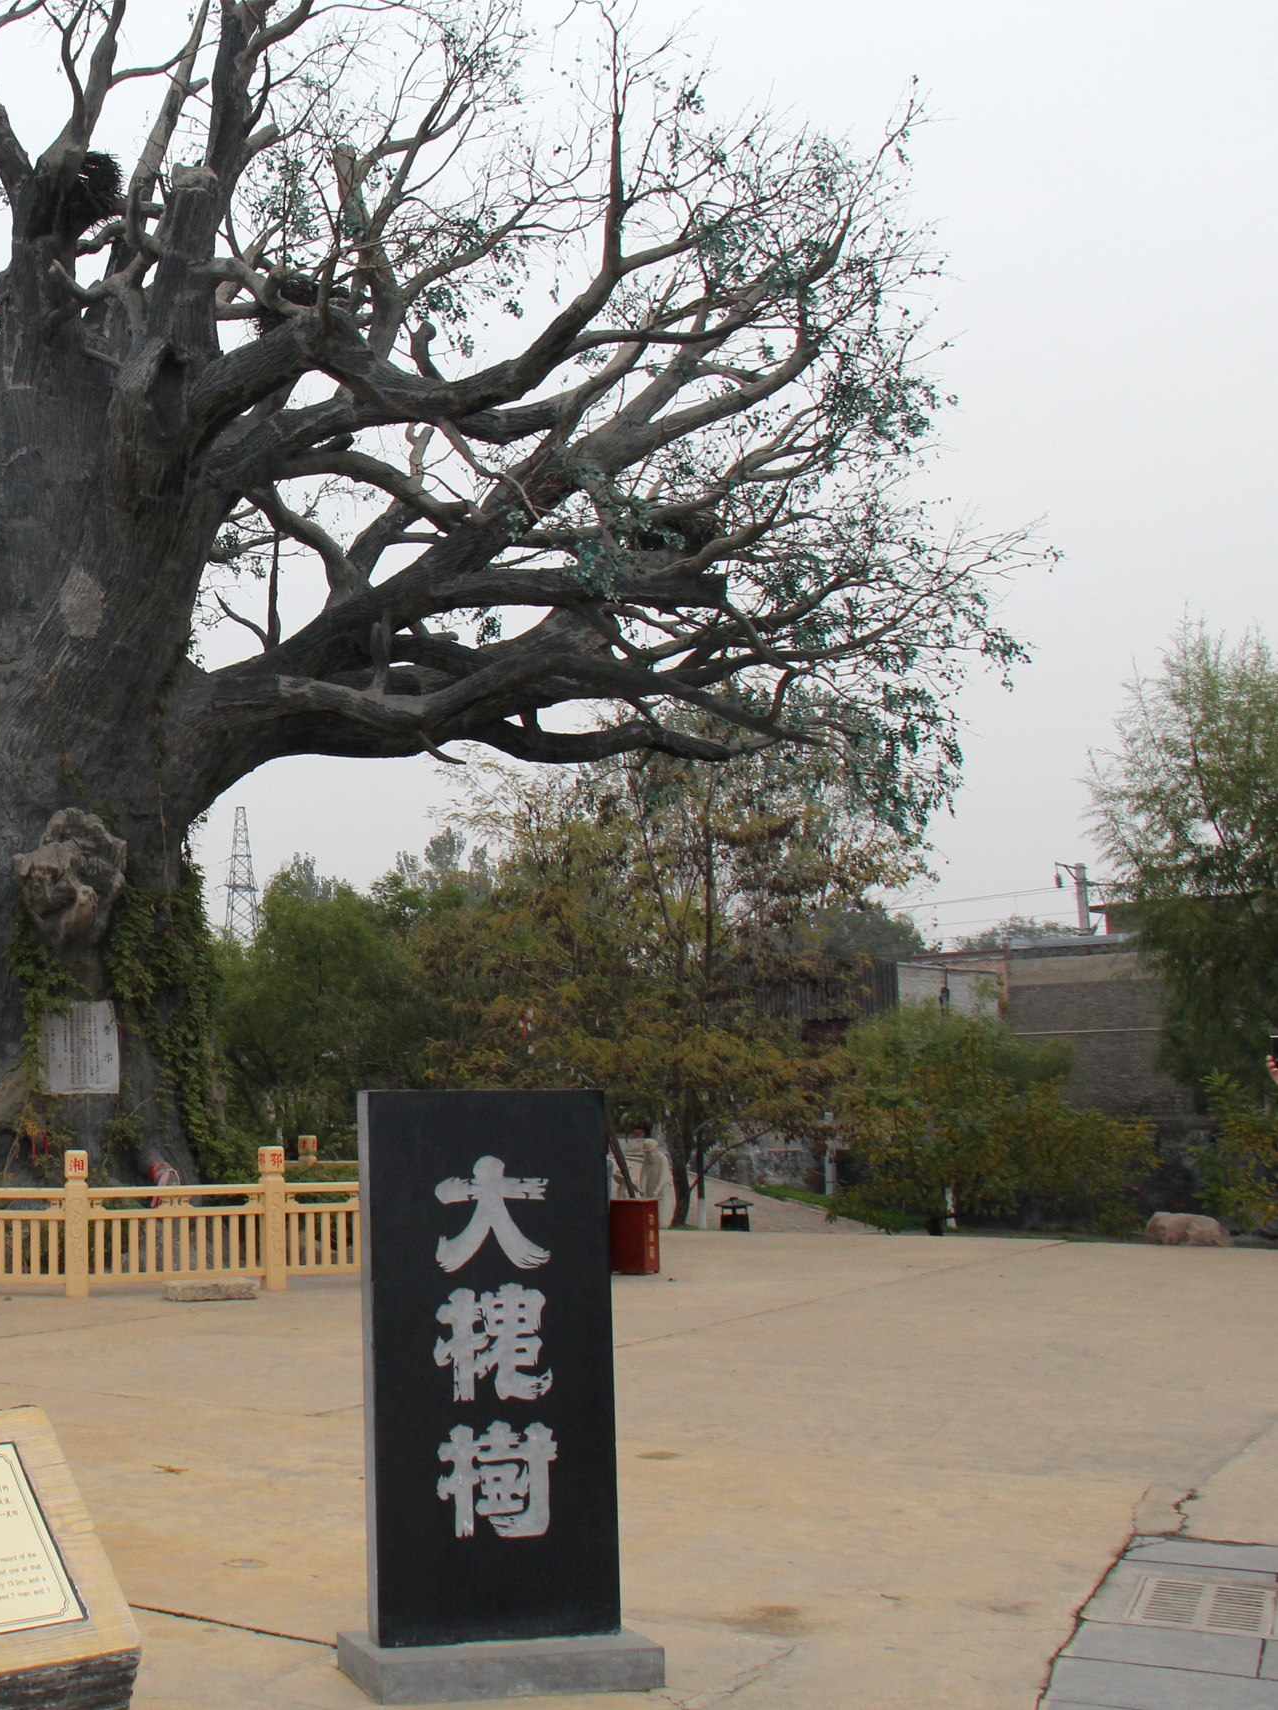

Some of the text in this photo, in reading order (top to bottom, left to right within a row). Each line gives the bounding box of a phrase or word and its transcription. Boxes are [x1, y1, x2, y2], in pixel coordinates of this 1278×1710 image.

[269, 1152, 283, 1168] 鄂
[69, 1157, 84, 1172] 湘
[0, 1554, 18, 1563] record
[29, 1563, 42, 1571] that
[28, 1576, 40, 1584] and
[33, 1587, 45, 1595] and
